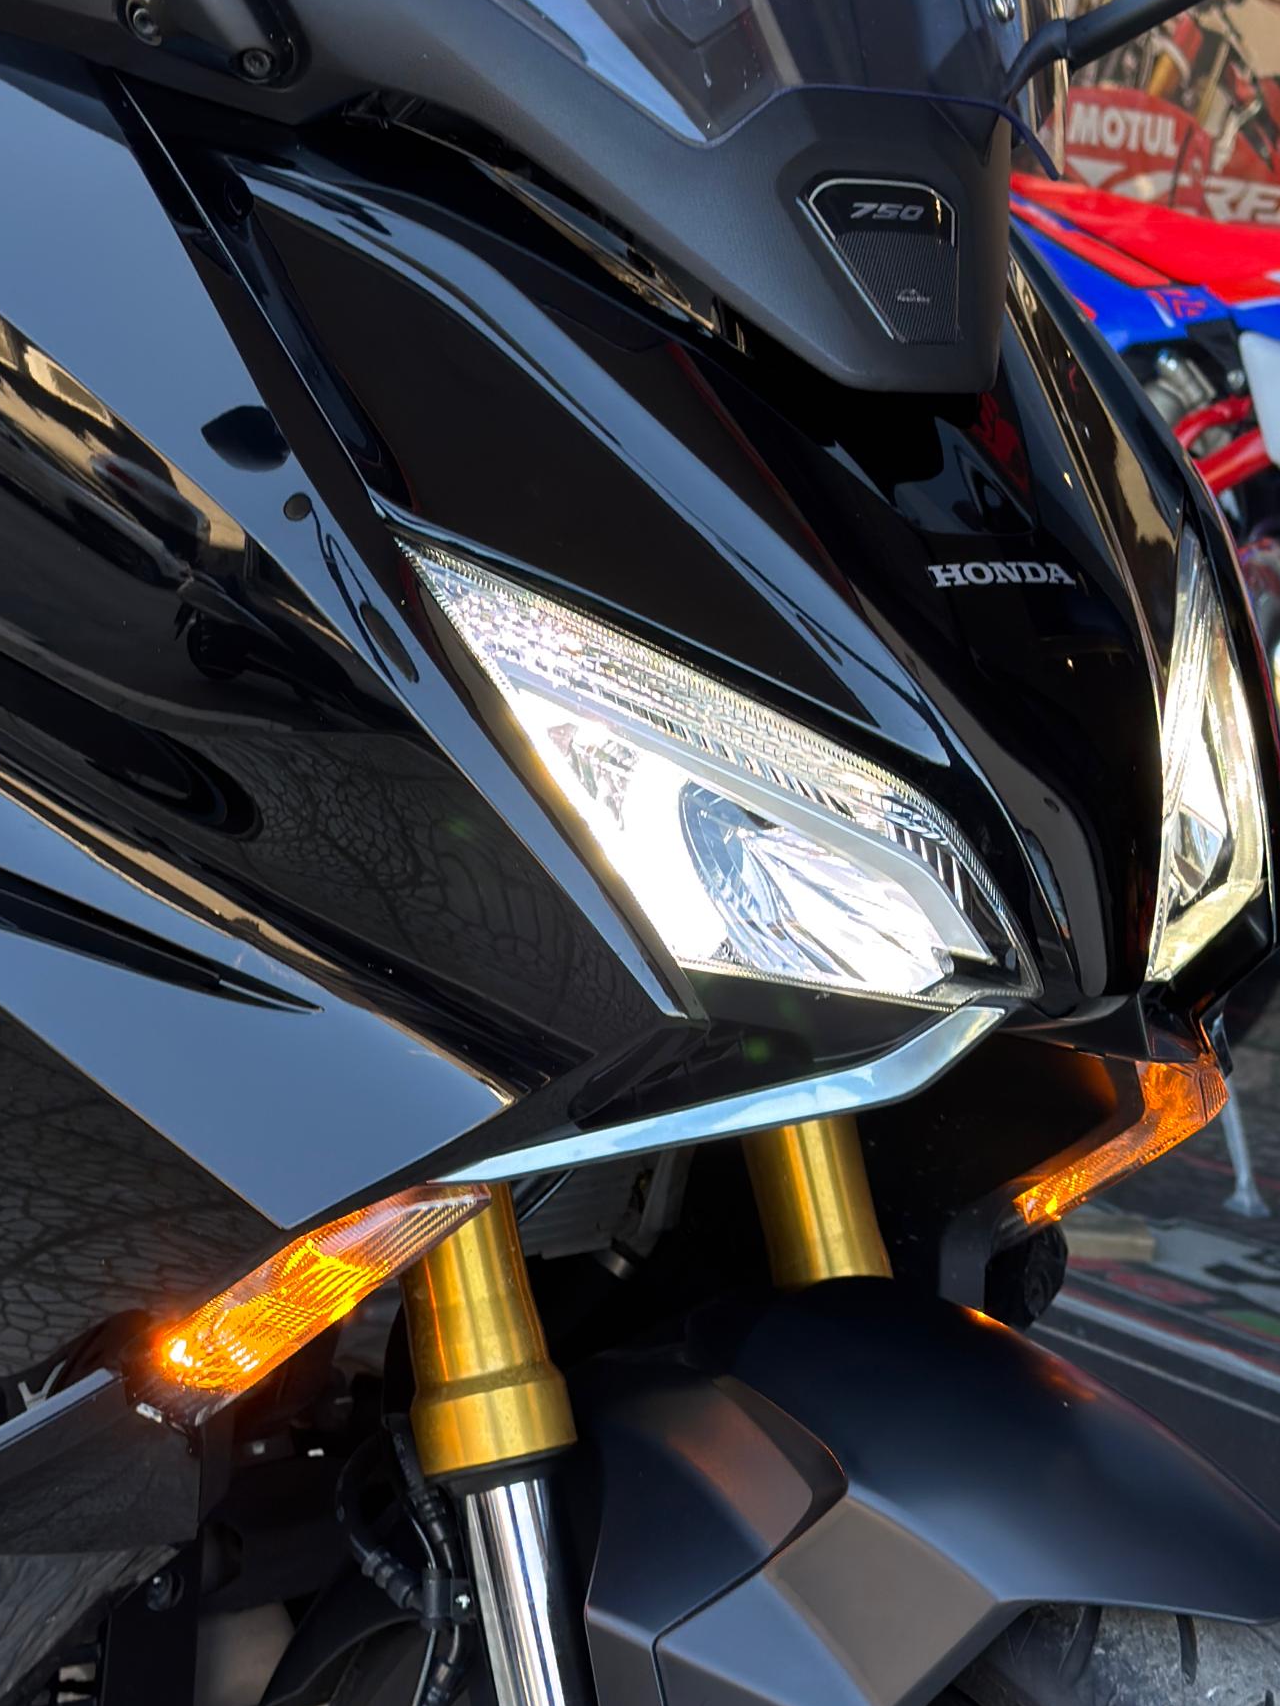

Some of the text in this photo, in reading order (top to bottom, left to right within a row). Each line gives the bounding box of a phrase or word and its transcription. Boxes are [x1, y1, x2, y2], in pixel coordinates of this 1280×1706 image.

[1070, 100, 1179, 159] MOTUL
[848, 200, 926, 223] 750
[926, 560, 1078, 590] HONDA
